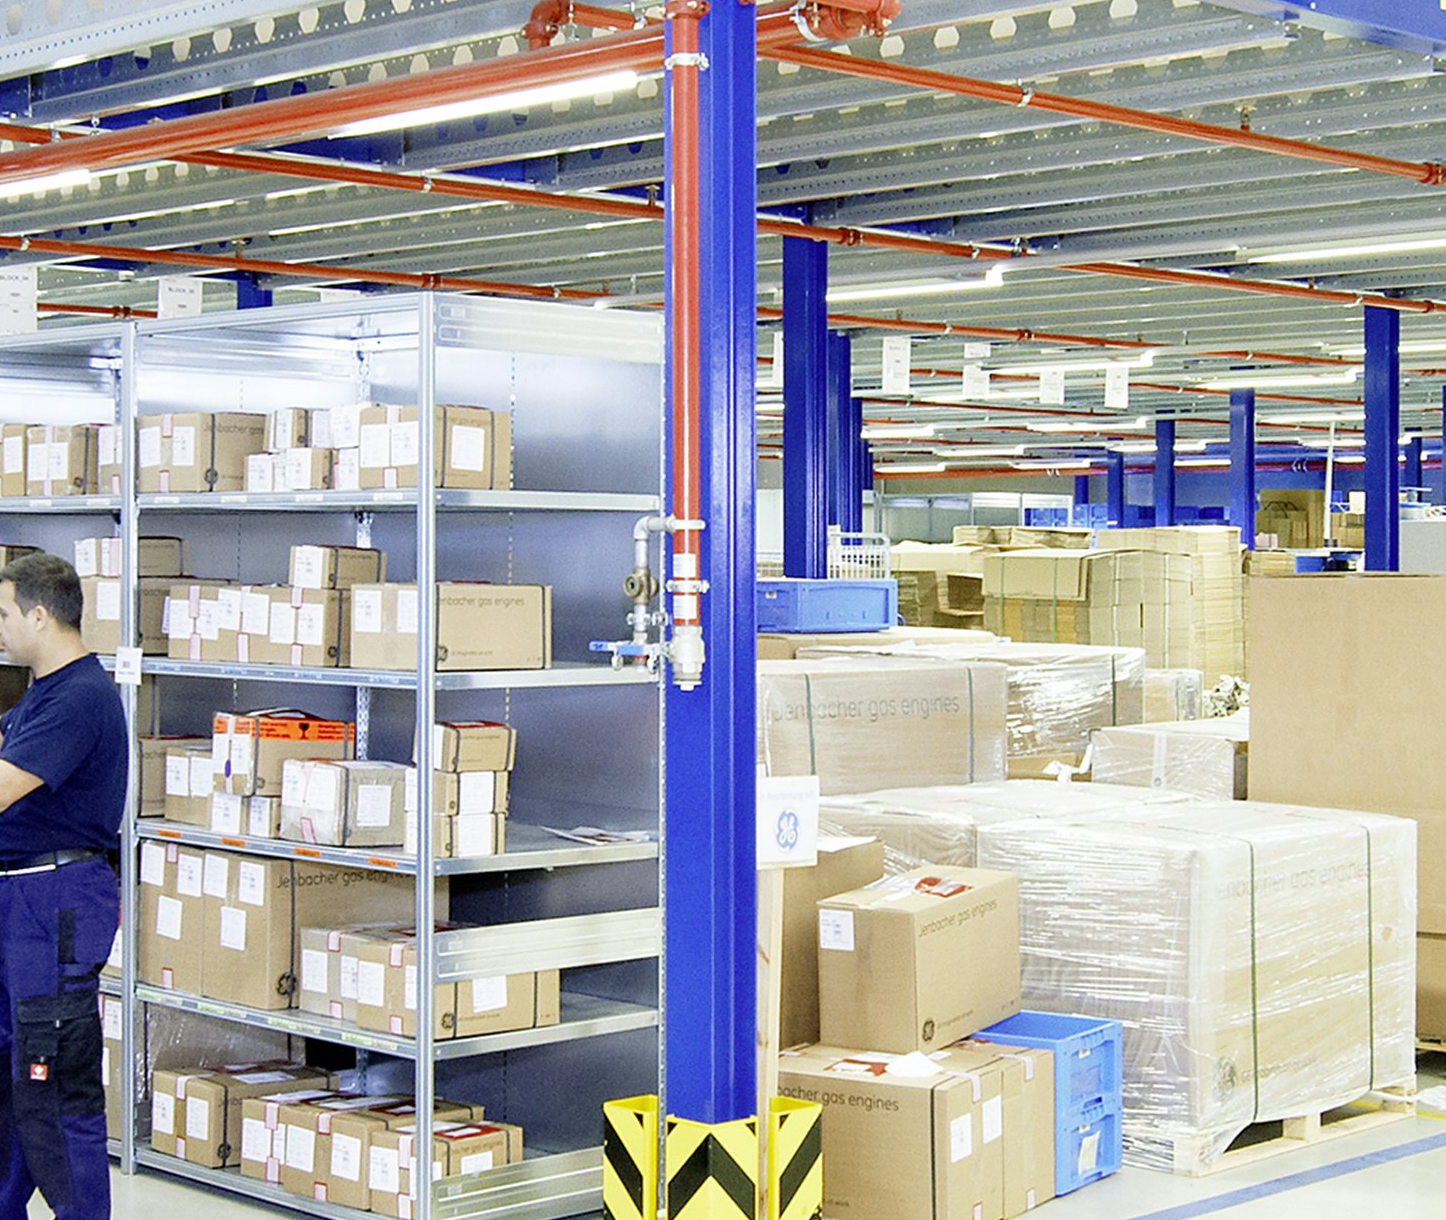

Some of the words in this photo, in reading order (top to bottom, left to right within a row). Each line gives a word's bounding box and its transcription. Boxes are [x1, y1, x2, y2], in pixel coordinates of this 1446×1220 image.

[868, 700, 897, 722] gas
[900, 694, 960, 720] engines
[277, 871, 339, 889] Jebacher
[342, 871, 364, 887] gas
[957, 908, 971, 927] gas
[971, 899, 999, 919] engines
[821, 1091, 846, 1107] gas
[848, 1091, 900, 1112] engines
